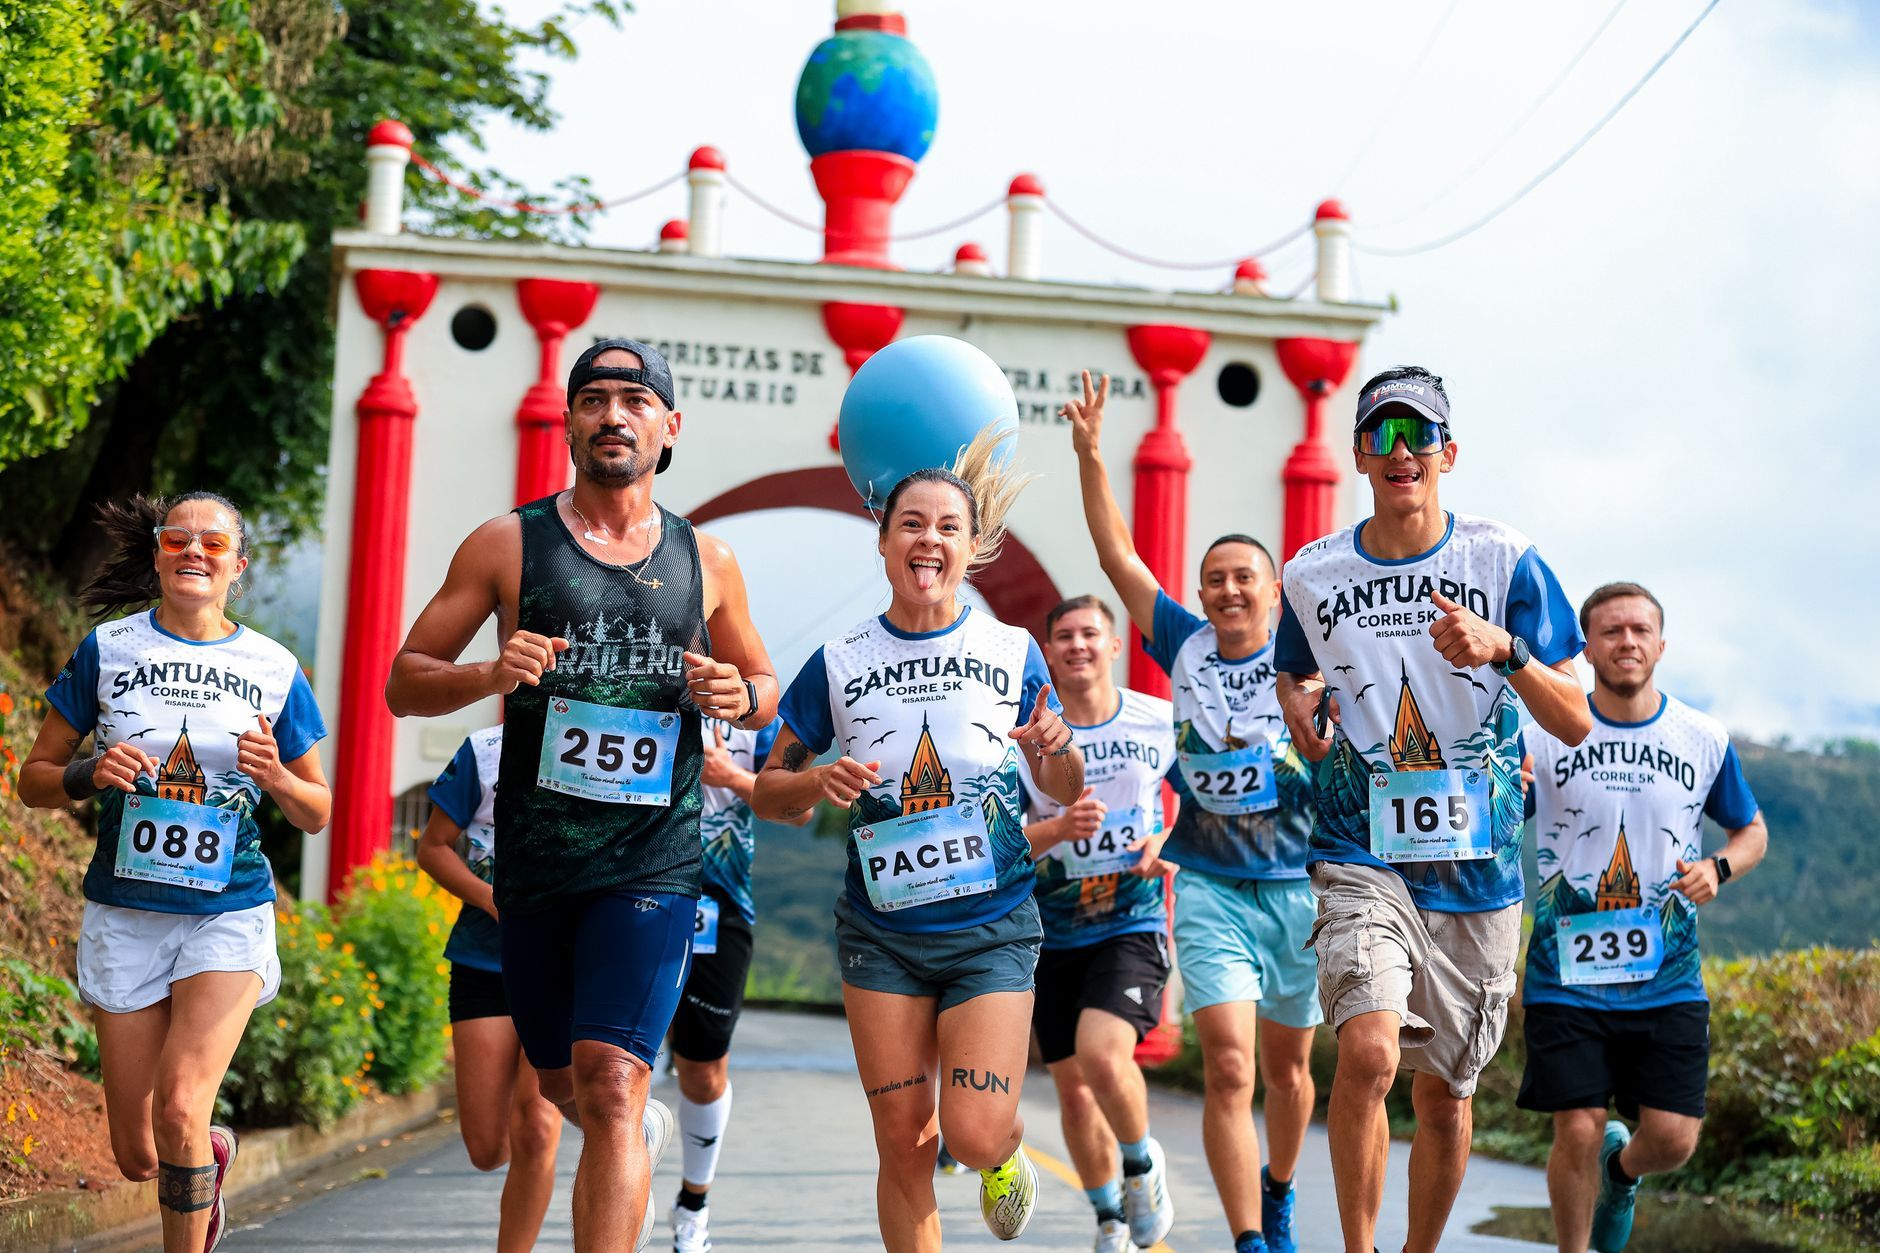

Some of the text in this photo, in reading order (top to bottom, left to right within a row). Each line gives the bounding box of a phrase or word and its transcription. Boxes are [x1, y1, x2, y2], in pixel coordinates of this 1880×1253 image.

[791, 351, 824, 377] DE
[1317, 573, 1489, 642] SANTUARIO
[1357, 610, 1438, 629] CORRE 5K
[1375, 628, 1422, 638] RISARALDA
[111, 660, 262, 711] SANTUARIO
[150, 686, 222, 702] CORRE 5K
[844, 654, 1009, 709] SANTUARIO
[886, 680, 963, 697] CORRE 5K
[164, 699, 207, 709] RISARALDA
[902, 694, 947, 704] RISARALDA
[560, 727, 658, 775] 259
[1080, 741, 1159, 770] TUARIO
[1193, 766, 1261, 796] 222
[1555, 741, 1696, 792] SANTUARIO
[1591, 771, 1655, 785] CORRE 5K
[1391, 795, 1469, 834] 165
[133, 820, 220, 864] 088
[1073, 826, 1137, 858] 043
[868, 835, 987, 881] PACER
[1574, 928, 1648, 963] 239
[952, 1068, 1010, 1095] RUN
